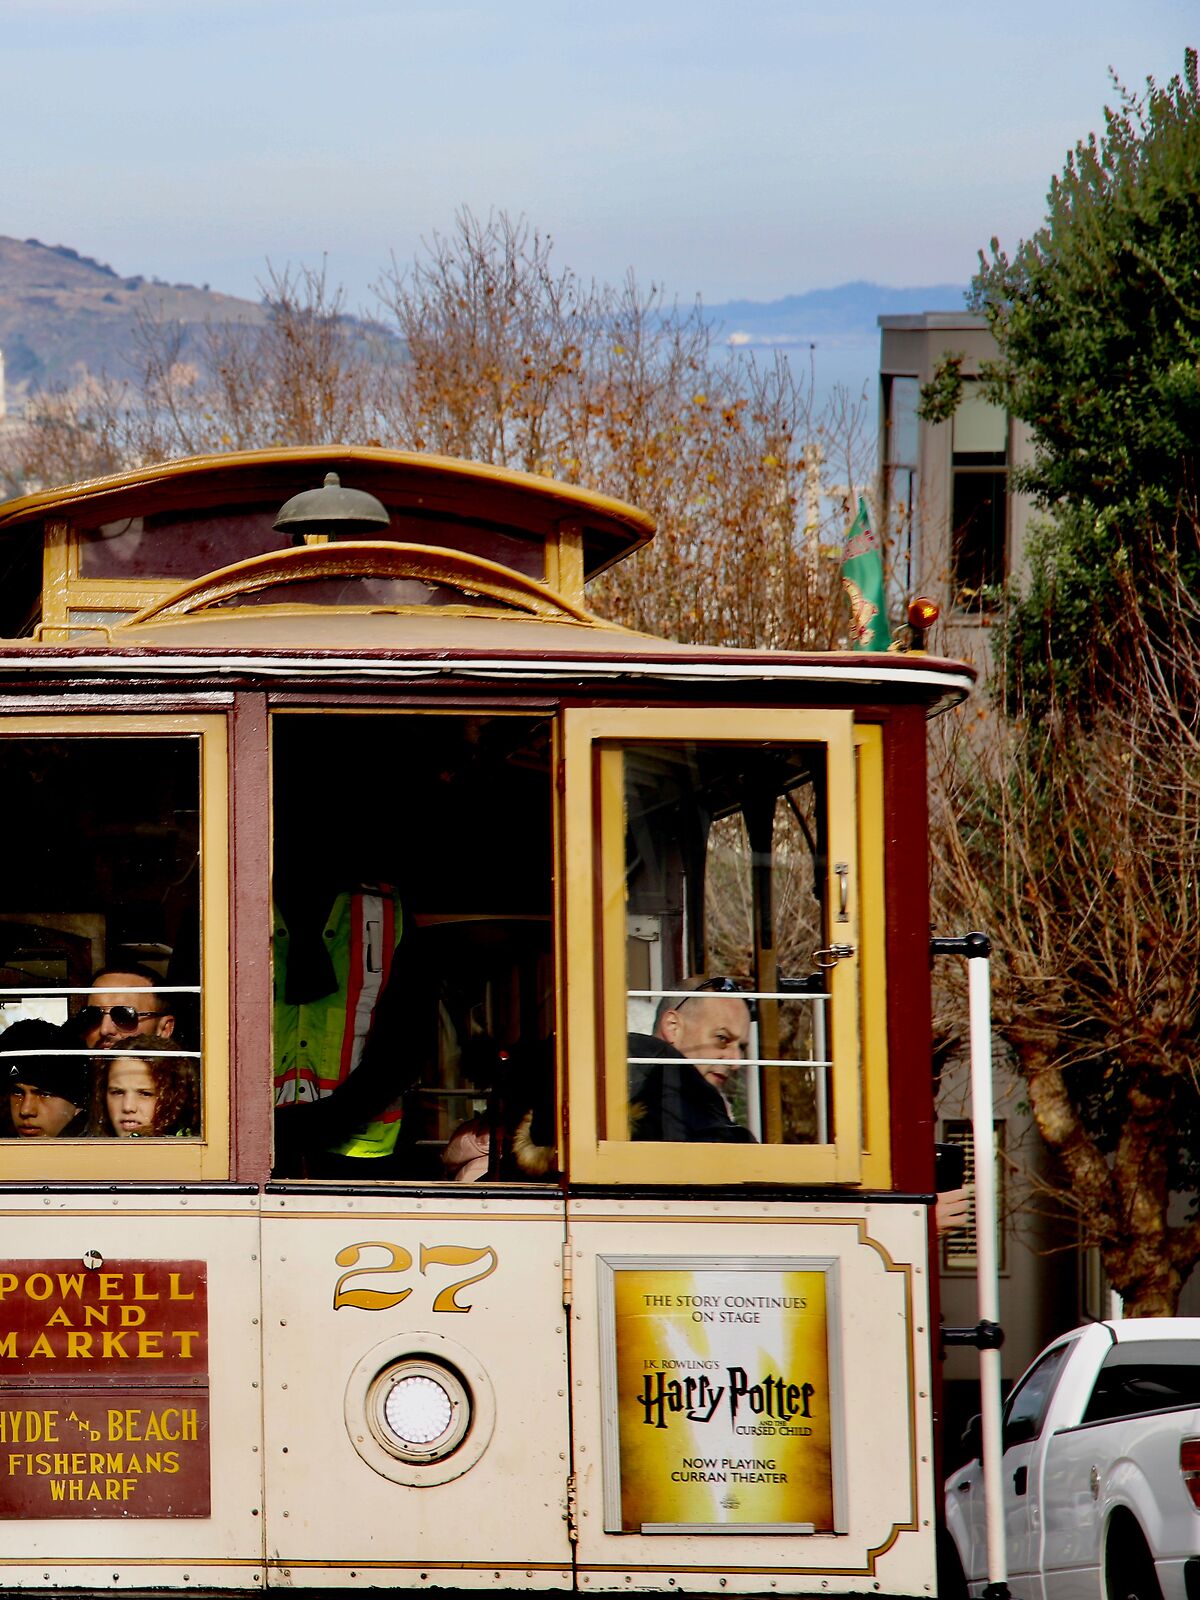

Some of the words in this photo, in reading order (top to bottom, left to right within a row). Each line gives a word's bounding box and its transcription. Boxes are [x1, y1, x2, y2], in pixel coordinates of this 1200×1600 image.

[333, 1240, 498, 1313] 27
[643, 1295, 672, 1307] THE
[676, 1295, 720, 1308] STORY
[723, 1296, 807, 1309] CONTINUES
[46, 1305, 147, 1327] AND
[691, 1311, 715, 1323] ON
[719, 1312, 761, 1324] STAGE
[643, 1360, 659, 1370] J.K.
[661, 1360, 720, 1370] ROWLING'S
[637, 1371, 725, 1429] Harry
[726, 1366, 816, 1434] Potter
[68, 1410, 101, 1442] AND
[107, 1408, 199, 1442] BEACH
[736, 1426, 776, 1436] CURSED
[778, 1426, 812, 1437] CHILD
[7, 1451, 181, 1475] FISHERMANS
[682, 1457, 718, 1469] NOW
[721, 1458, 777, 1470] PLAYING
[671, 1471, 728, 1483] CURRAN
[730, 1472, 788, 1484] THEATER
[49, 1478, 139, 1501] WHARF
